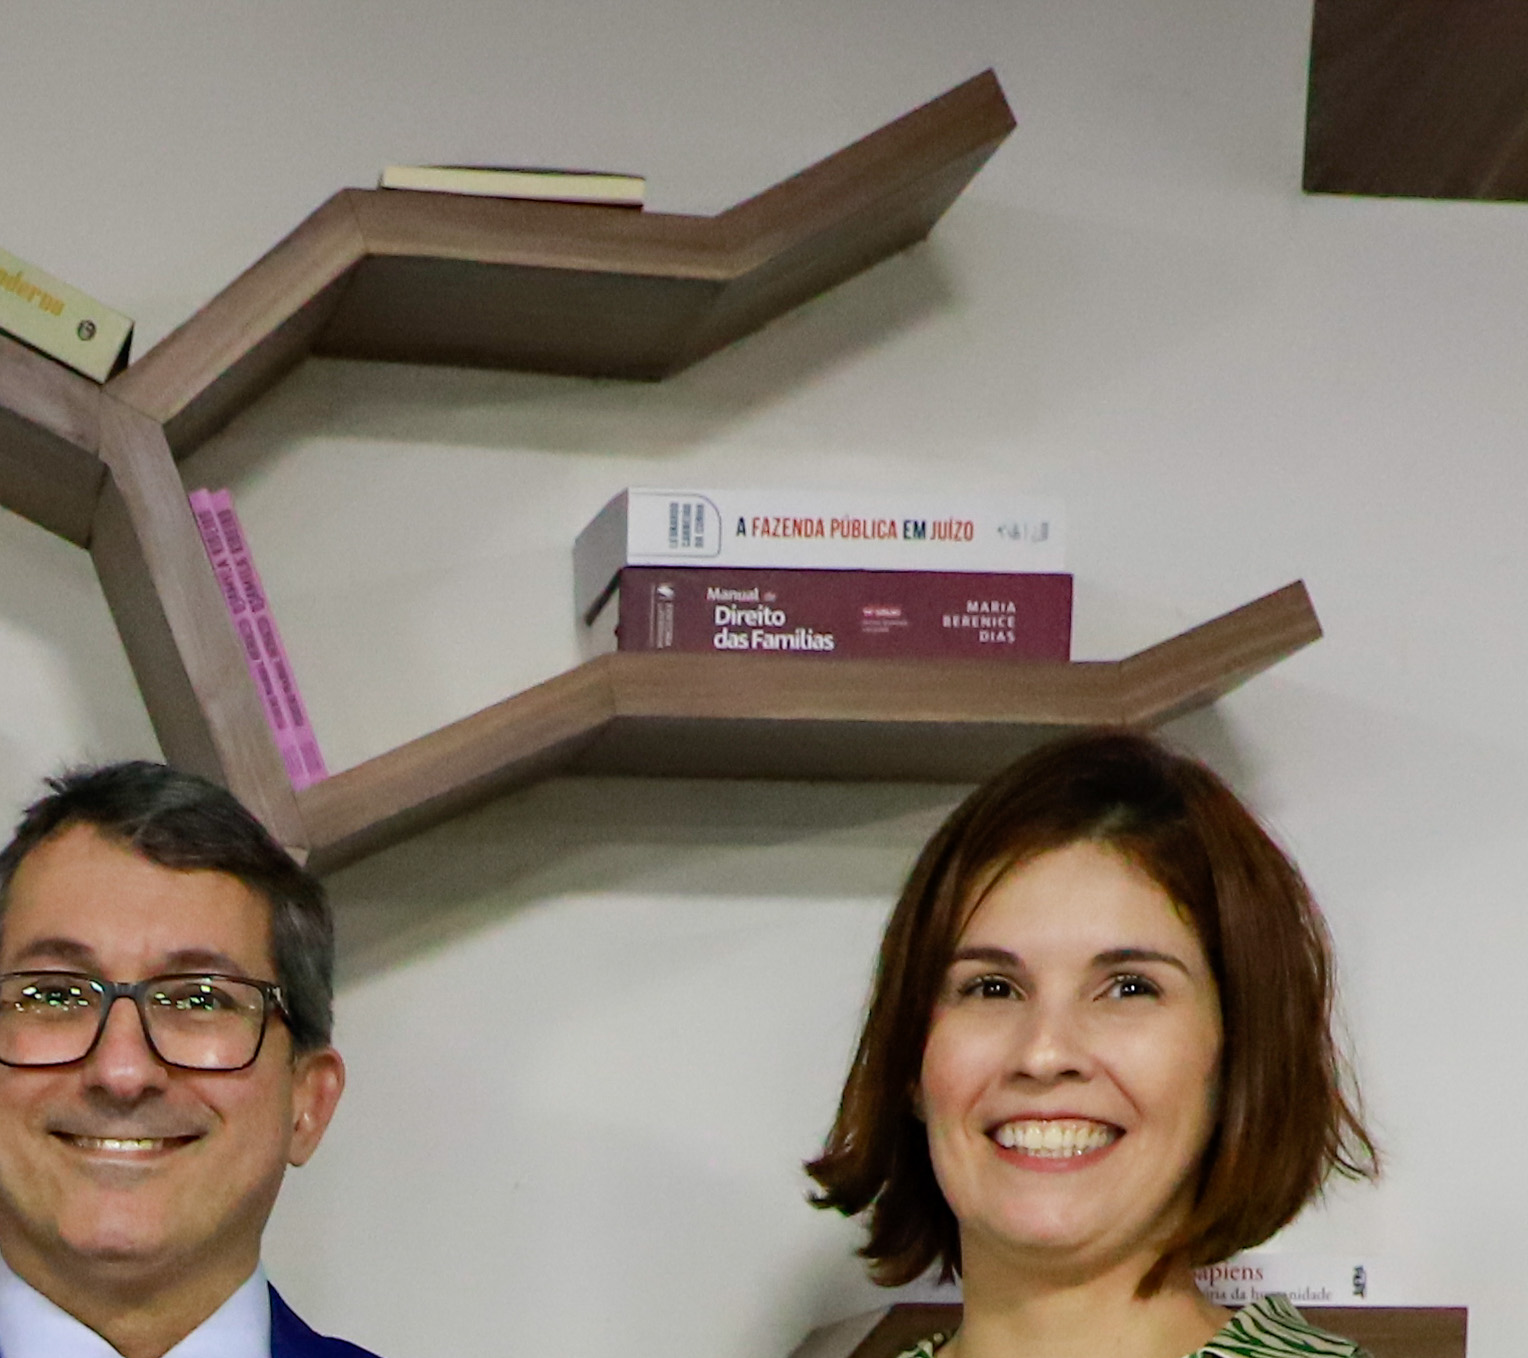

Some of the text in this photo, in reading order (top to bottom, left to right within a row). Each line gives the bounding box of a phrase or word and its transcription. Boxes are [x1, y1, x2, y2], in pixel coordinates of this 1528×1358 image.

[736, 513, 974, 542] A FAZENDA PÚBLICA EM JUÍZO
[706, 587, 760, 601] Manual
[966, 600, 1016, 613] MARIA
[714, 605, 786, 628] Direito
[942, 615, 1015, 628] BERENICE
[713, 628, 834, 651] das Famílias
[979, 630, 1015, 643] DIAS
[1194, 1261, 1263, 1286] apiens
[1230, 1287, 1245, 1300] da
